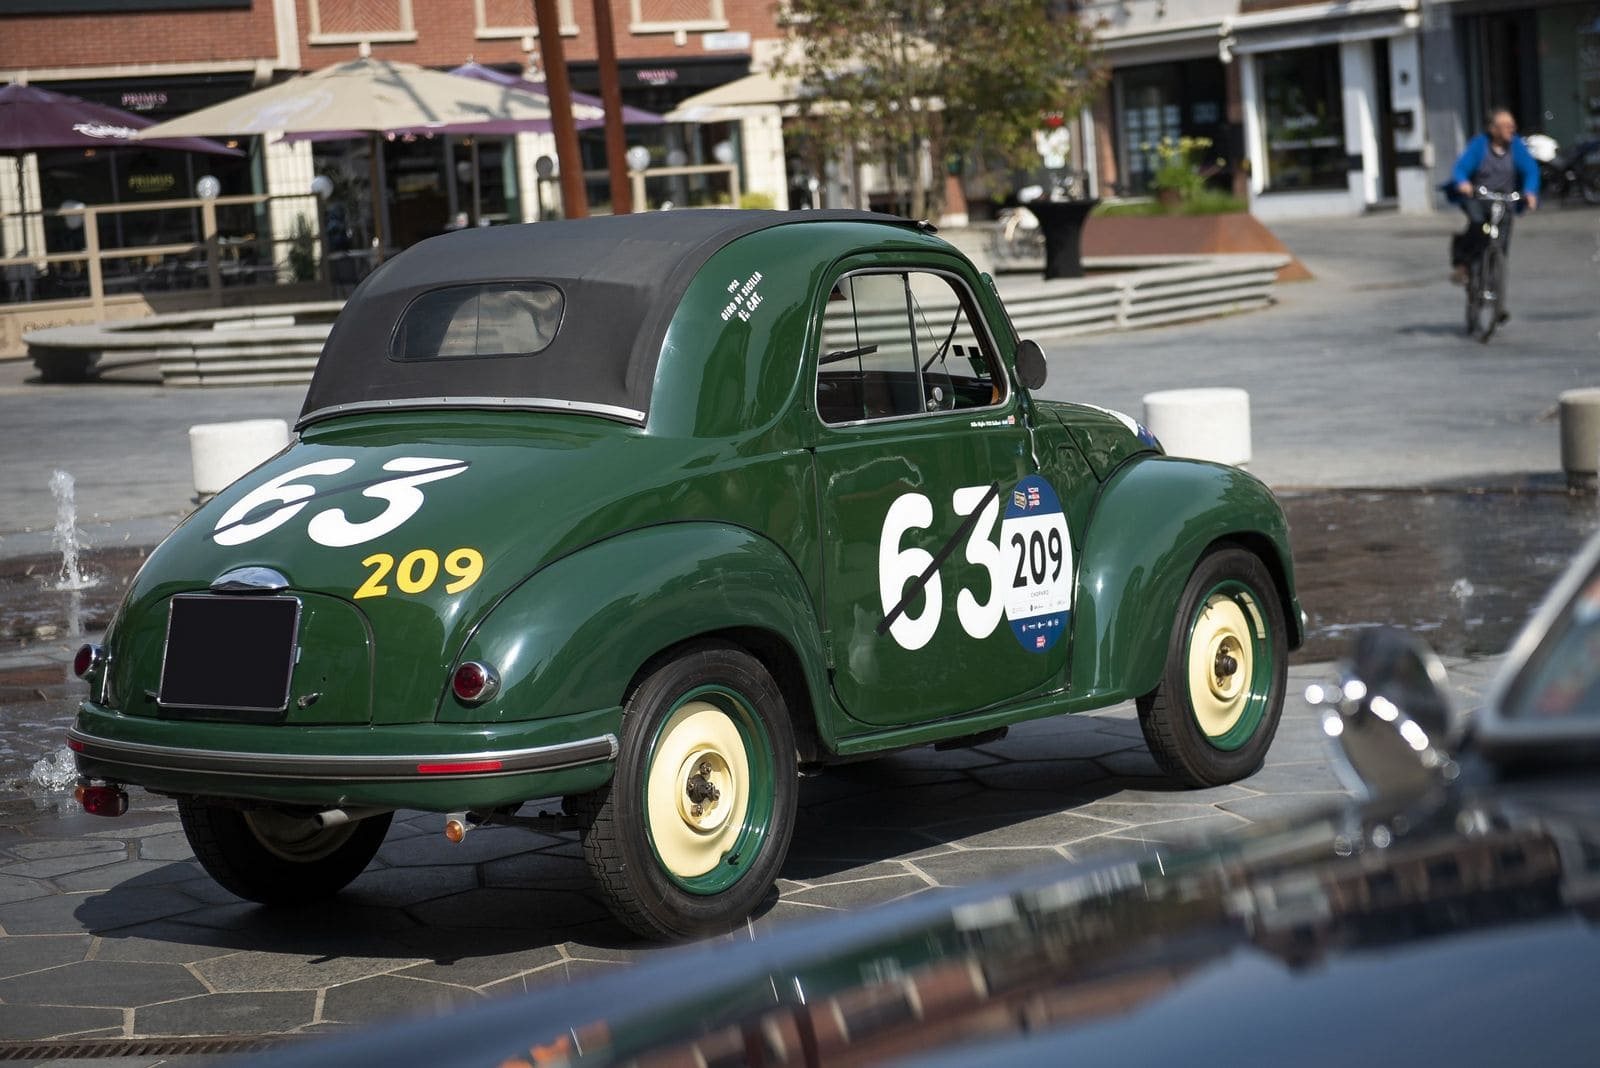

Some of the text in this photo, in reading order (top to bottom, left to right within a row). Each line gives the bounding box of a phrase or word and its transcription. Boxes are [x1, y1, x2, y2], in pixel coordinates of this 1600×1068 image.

[121, 91, 168, 106] PRIMUS
[128, 174, 175, 188] PRIMUS
[721, 271, 763, 321] GIRO DI SICILIA
[213, 457, 469, 547] 63
[353, 548, 484, 599] 209
[879, 485, 1004, 650] 63
[1011, 528, 1062, 588] 209
